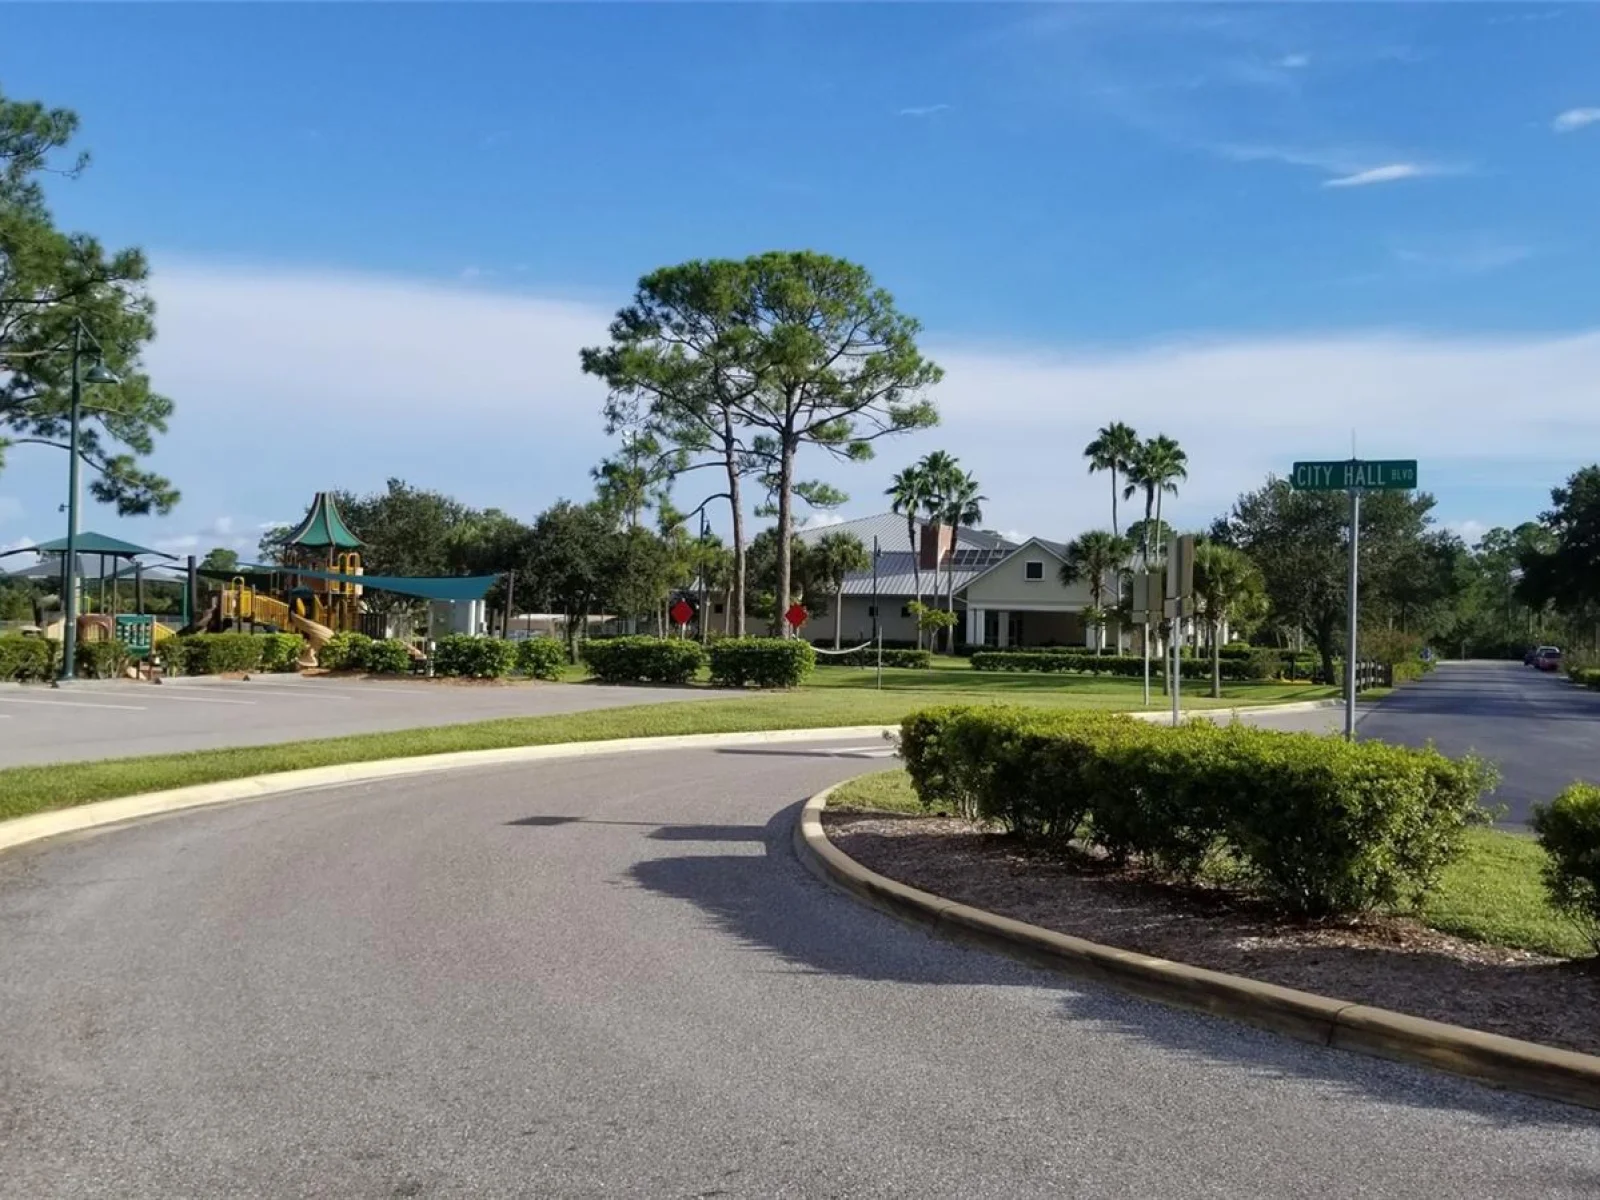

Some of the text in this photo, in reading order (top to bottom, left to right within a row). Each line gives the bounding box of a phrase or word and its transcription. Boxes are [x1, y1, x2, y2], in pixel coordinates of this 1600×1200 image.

[1297, 464, 1414, 486] CITY HALL BLVD
